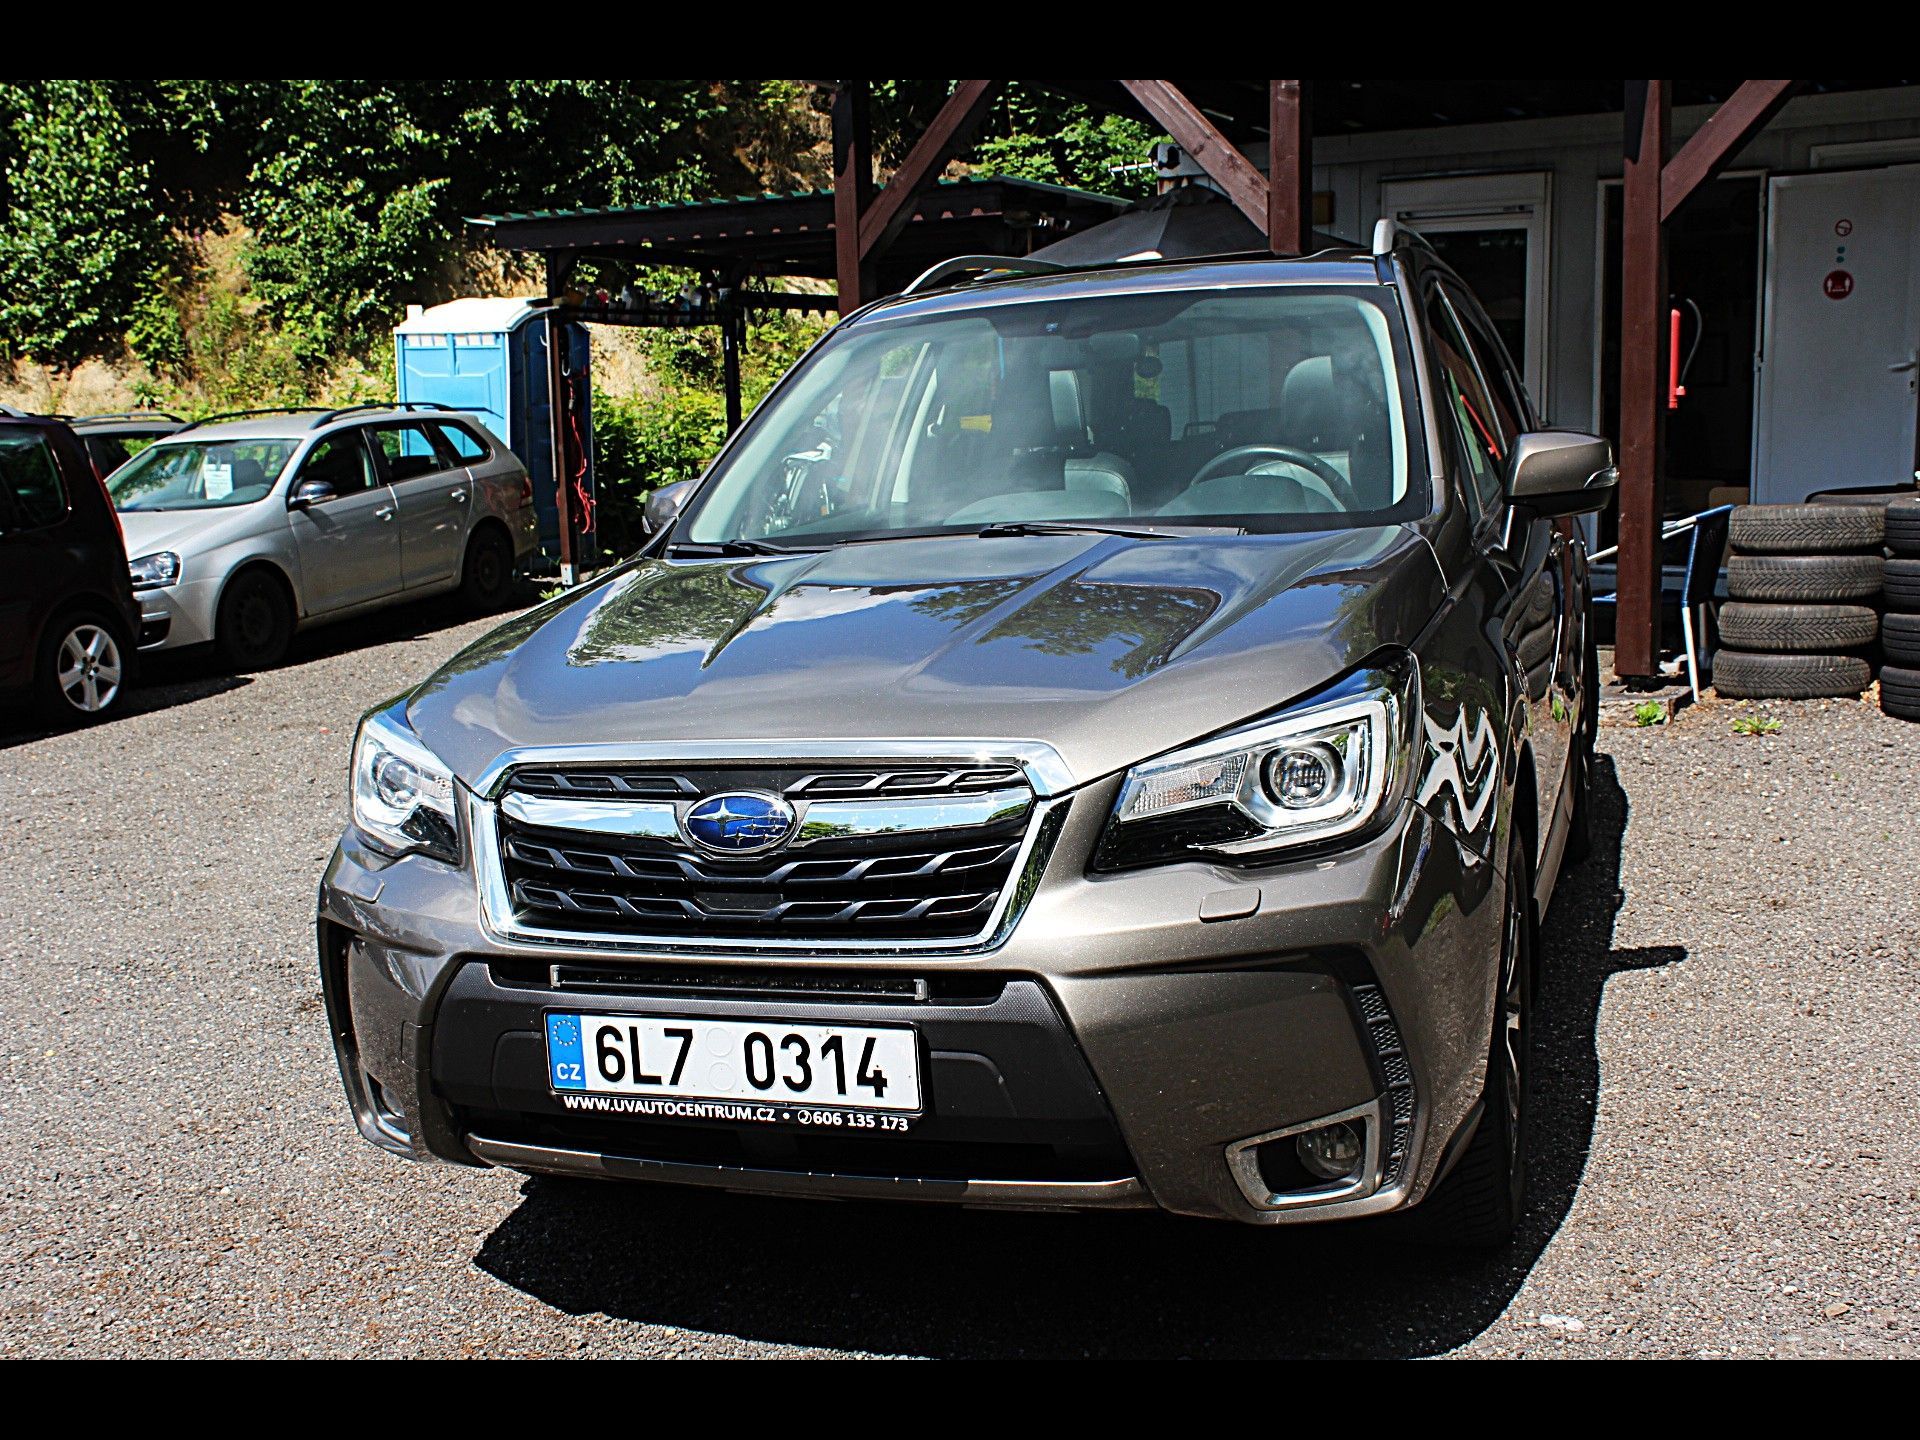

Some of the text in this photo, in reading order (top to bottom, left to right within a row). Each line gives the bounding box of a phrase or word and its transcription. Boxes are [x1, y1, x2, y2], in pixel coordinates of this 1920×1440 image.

[556, 1062, 582, 1081] CZ
[595, 1025, 888, 1098] 6L7 0314
[563, 1096, 909, 1132] WWW.UVAUTOCENTRUM.CZ 606 135 173
